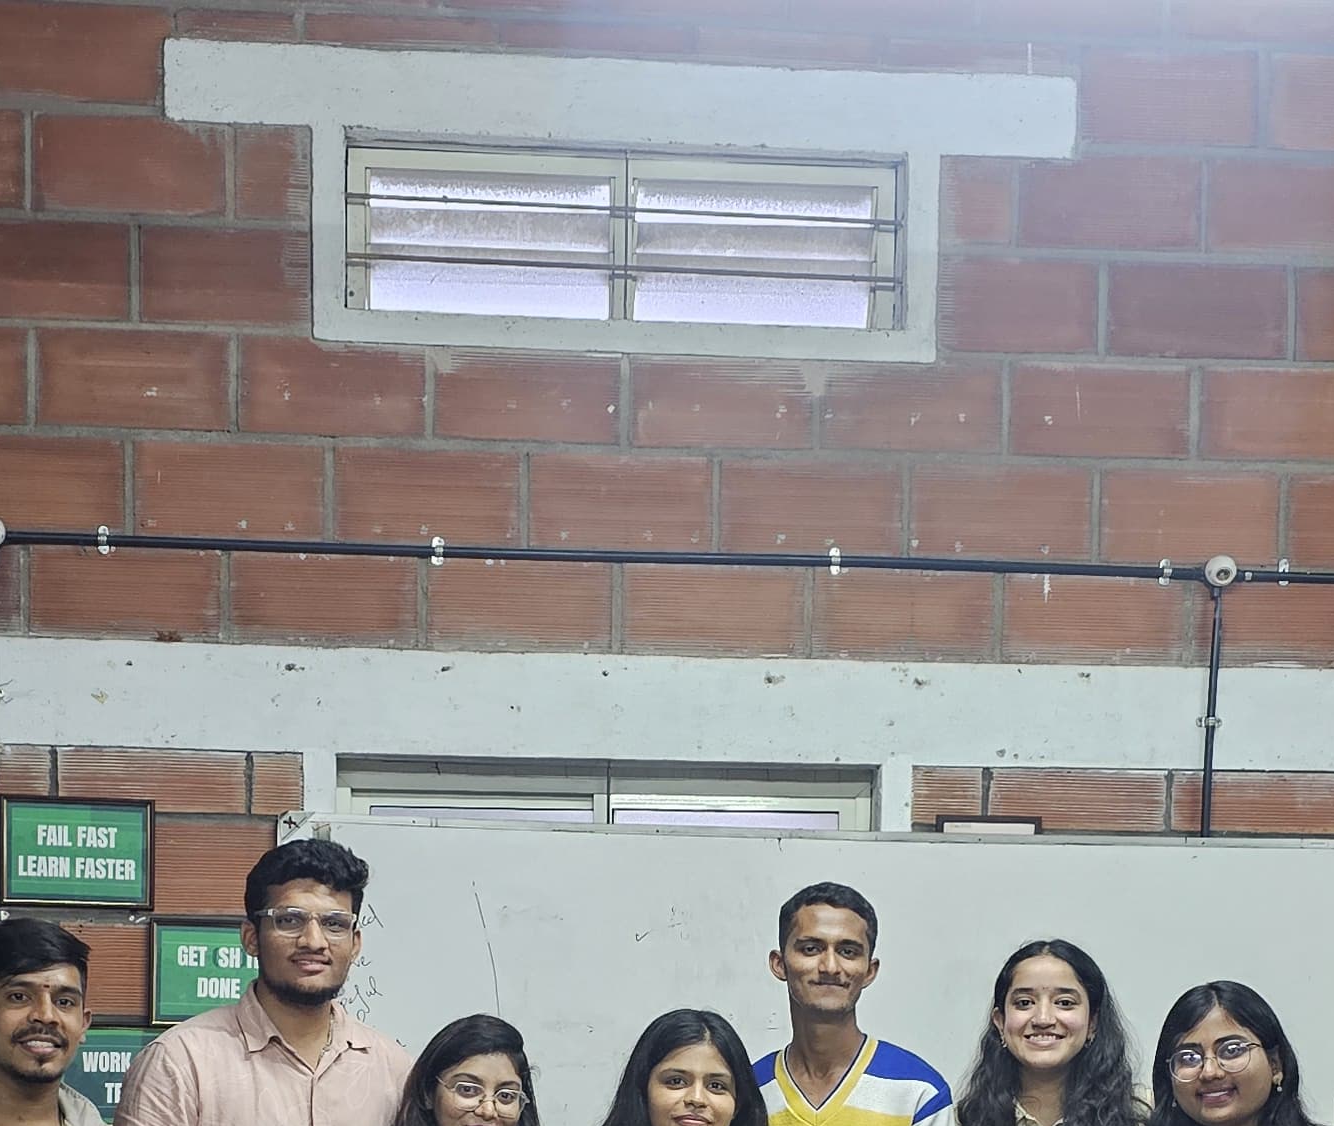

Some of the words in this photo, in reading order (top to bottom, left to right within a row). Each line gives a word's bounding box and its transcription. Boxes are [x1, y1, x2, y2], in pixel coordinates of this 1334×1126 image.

[37, 825, 72, 846] FAIL
[77, 826, 117, 848] FAST
[18, 856, 70, 878] LEARN
[75, 858, 136, 880] FASTER
[178, 945, 208, 968] GET
[197, 976, 241, 1000] DONE
[82, 1051, 132, 1073] WORK
